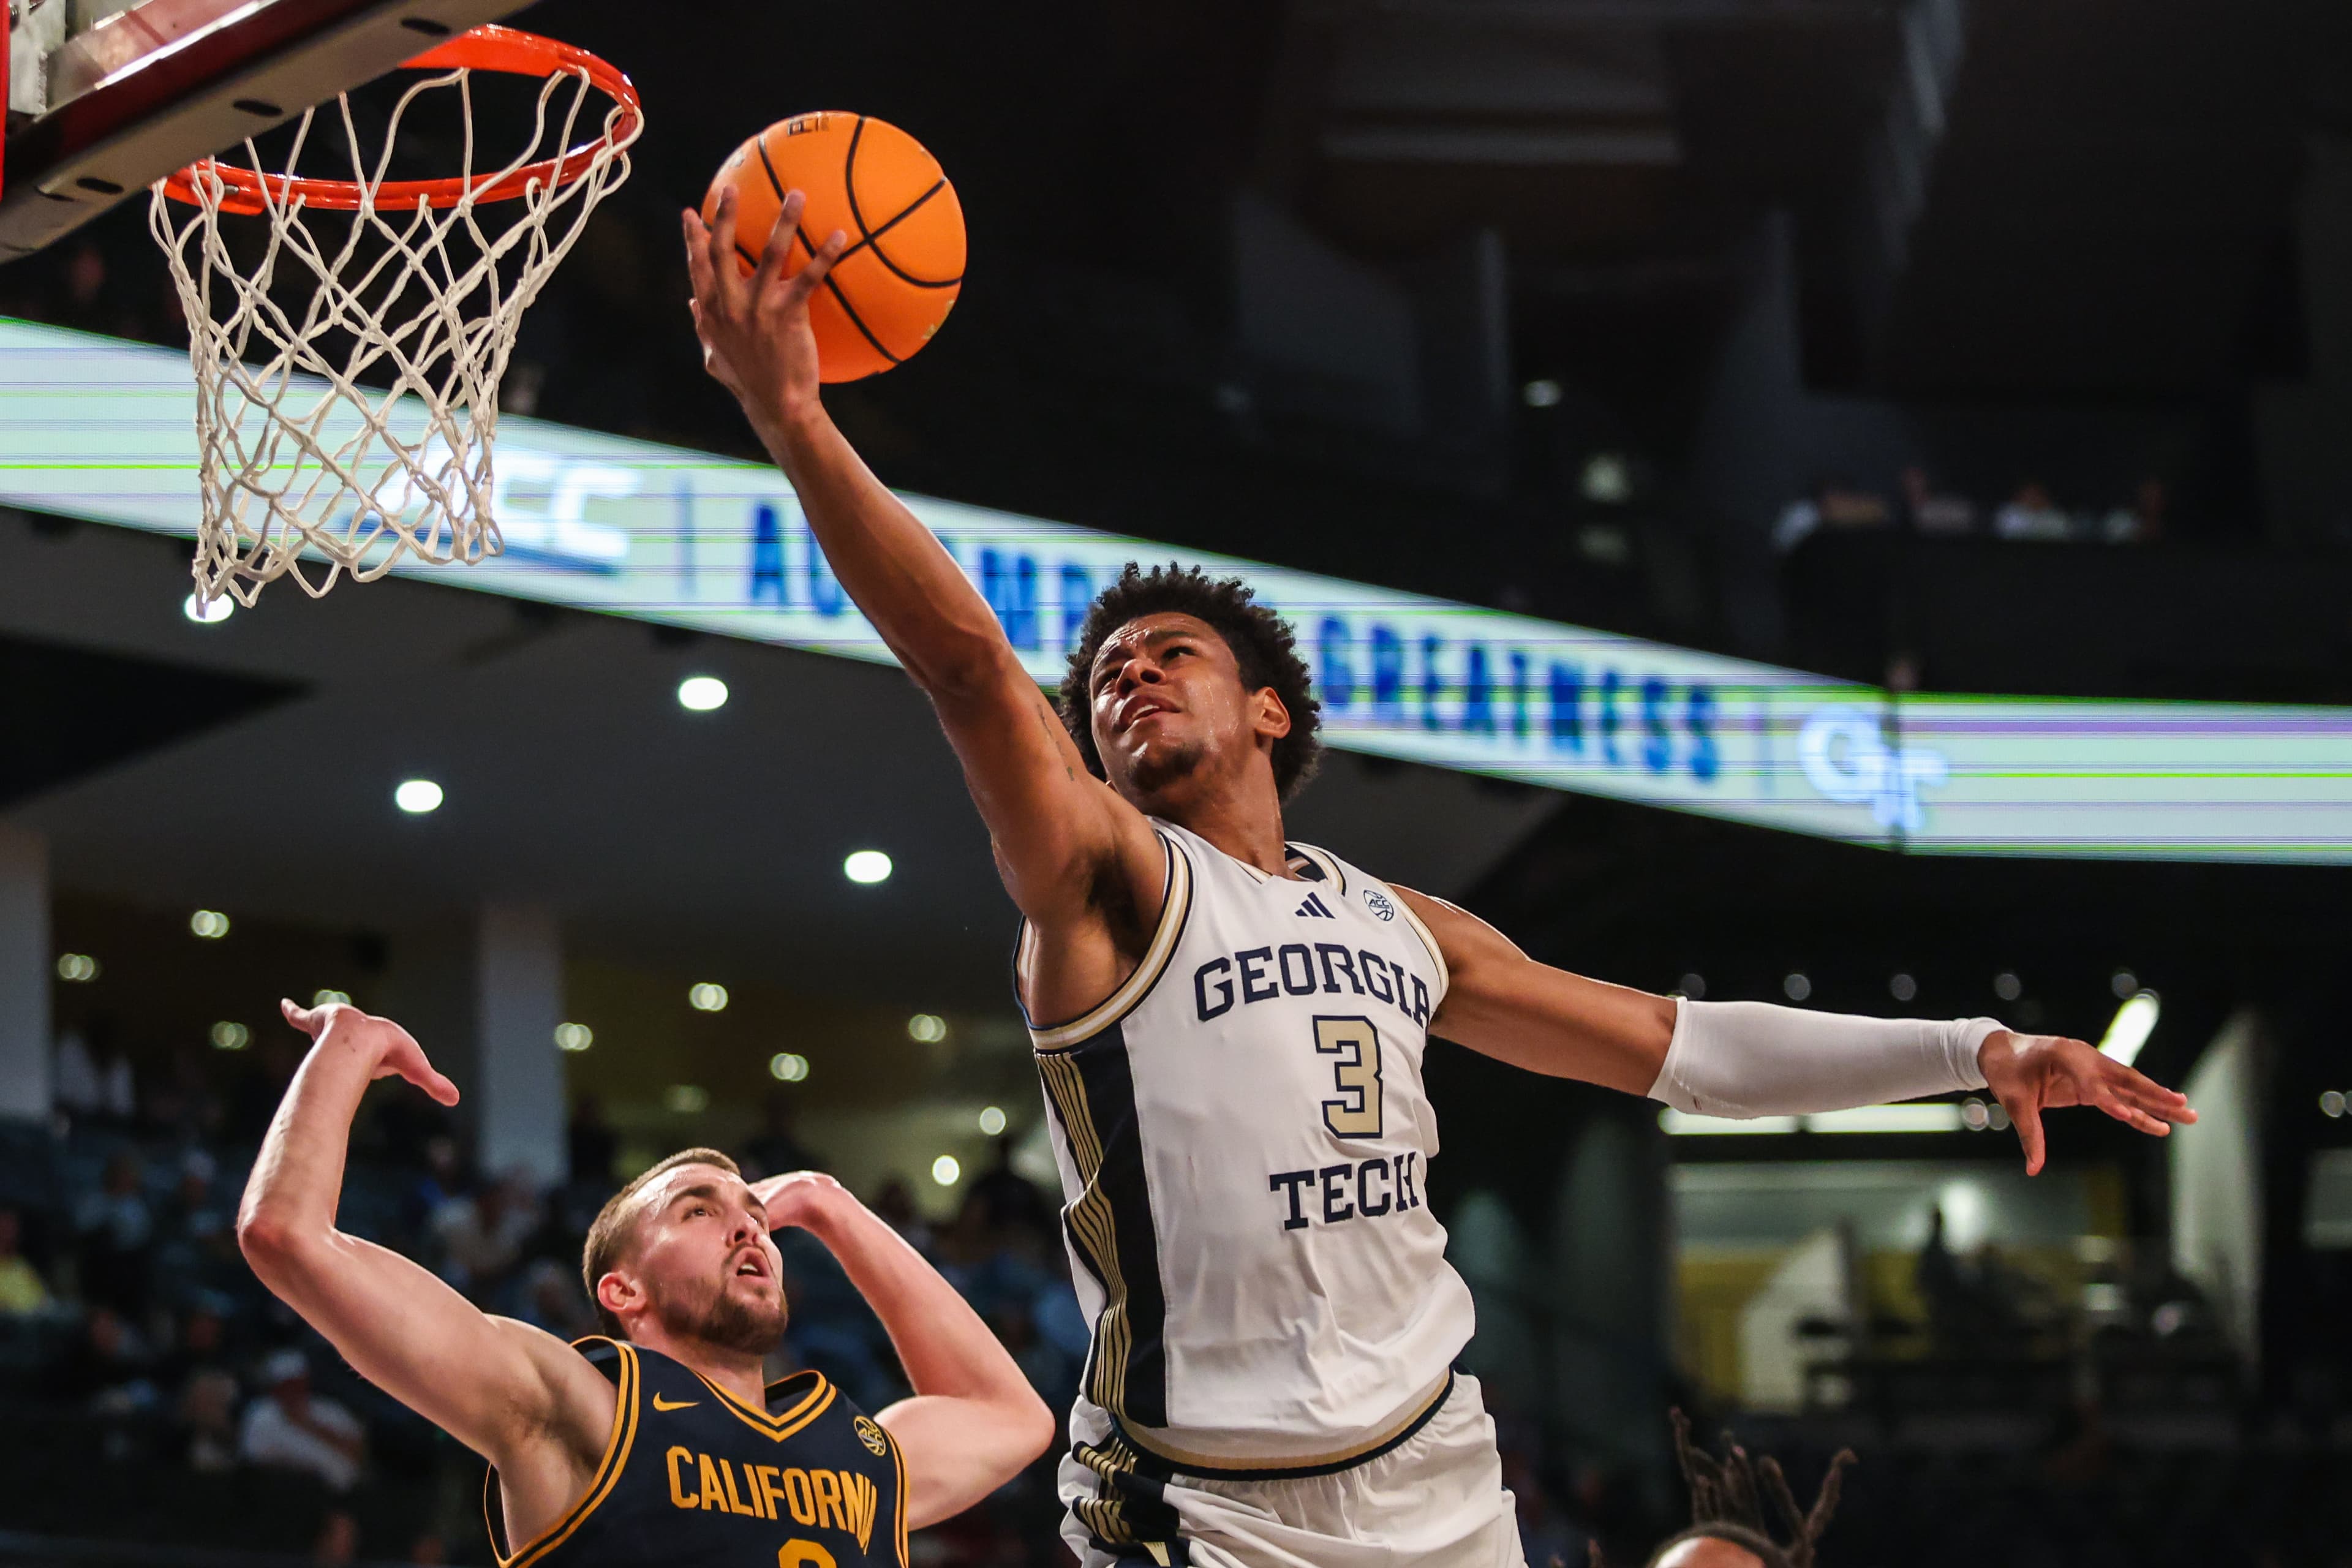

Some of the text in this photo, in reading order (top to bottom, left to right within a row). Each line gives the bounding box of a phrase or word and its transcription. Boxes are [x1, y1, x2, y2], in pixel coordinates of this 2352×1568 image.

[1317, 614, 1719, 782] GREATNESS
[1368, 898, 1390, 909] ACC
[1194, 943, 1430, 1029] GEORGIA
[1313, 1014, 1383, 1139] 3
[1269, 1152, 1420, 1231] TECH
